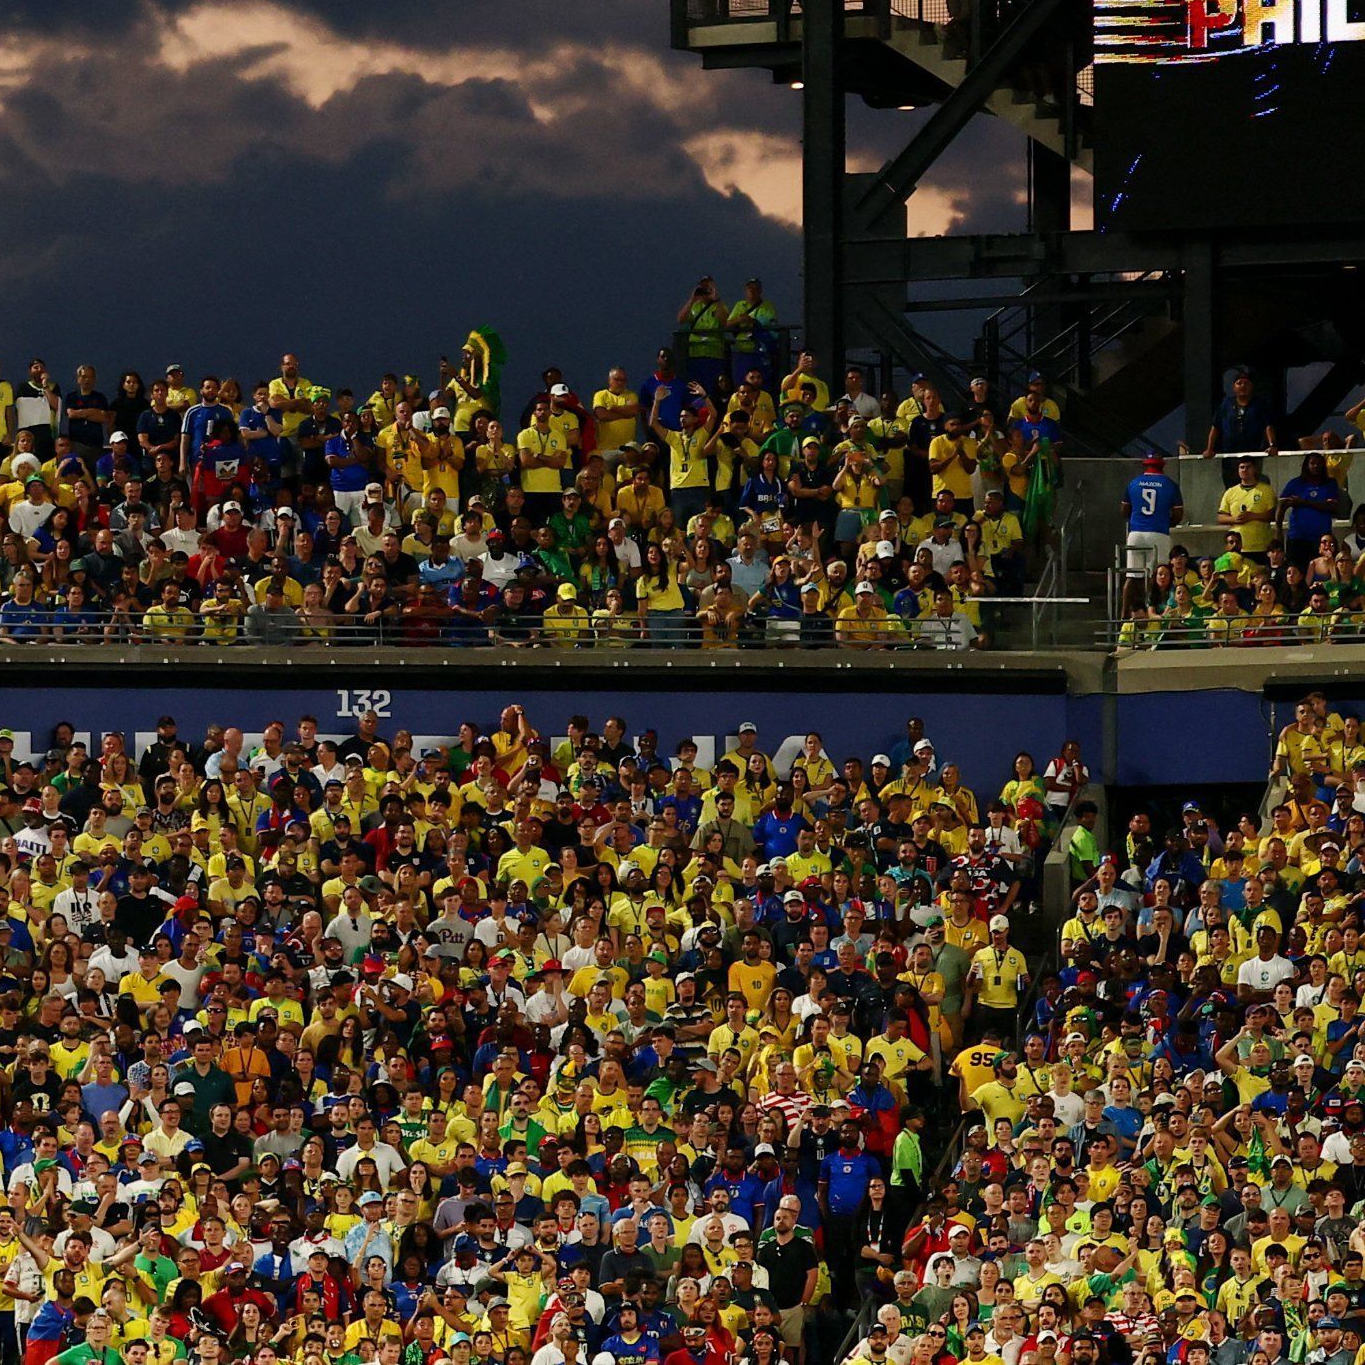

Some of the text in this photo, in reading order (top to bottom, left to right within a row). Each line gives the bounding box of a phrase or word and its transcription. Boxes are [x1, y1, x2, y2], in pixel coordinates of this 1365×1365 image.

[1141, 488, 1157, 516] 9
[336, 689, 392, 718] 132
[16, 838, 47, 857] HAITI
[438, 928, 465, 944] Pitt
[751, 980, 761, 990] 10
[970, 1051, 996, 1068] 95
[816, 1149, 825, 1161] 10
